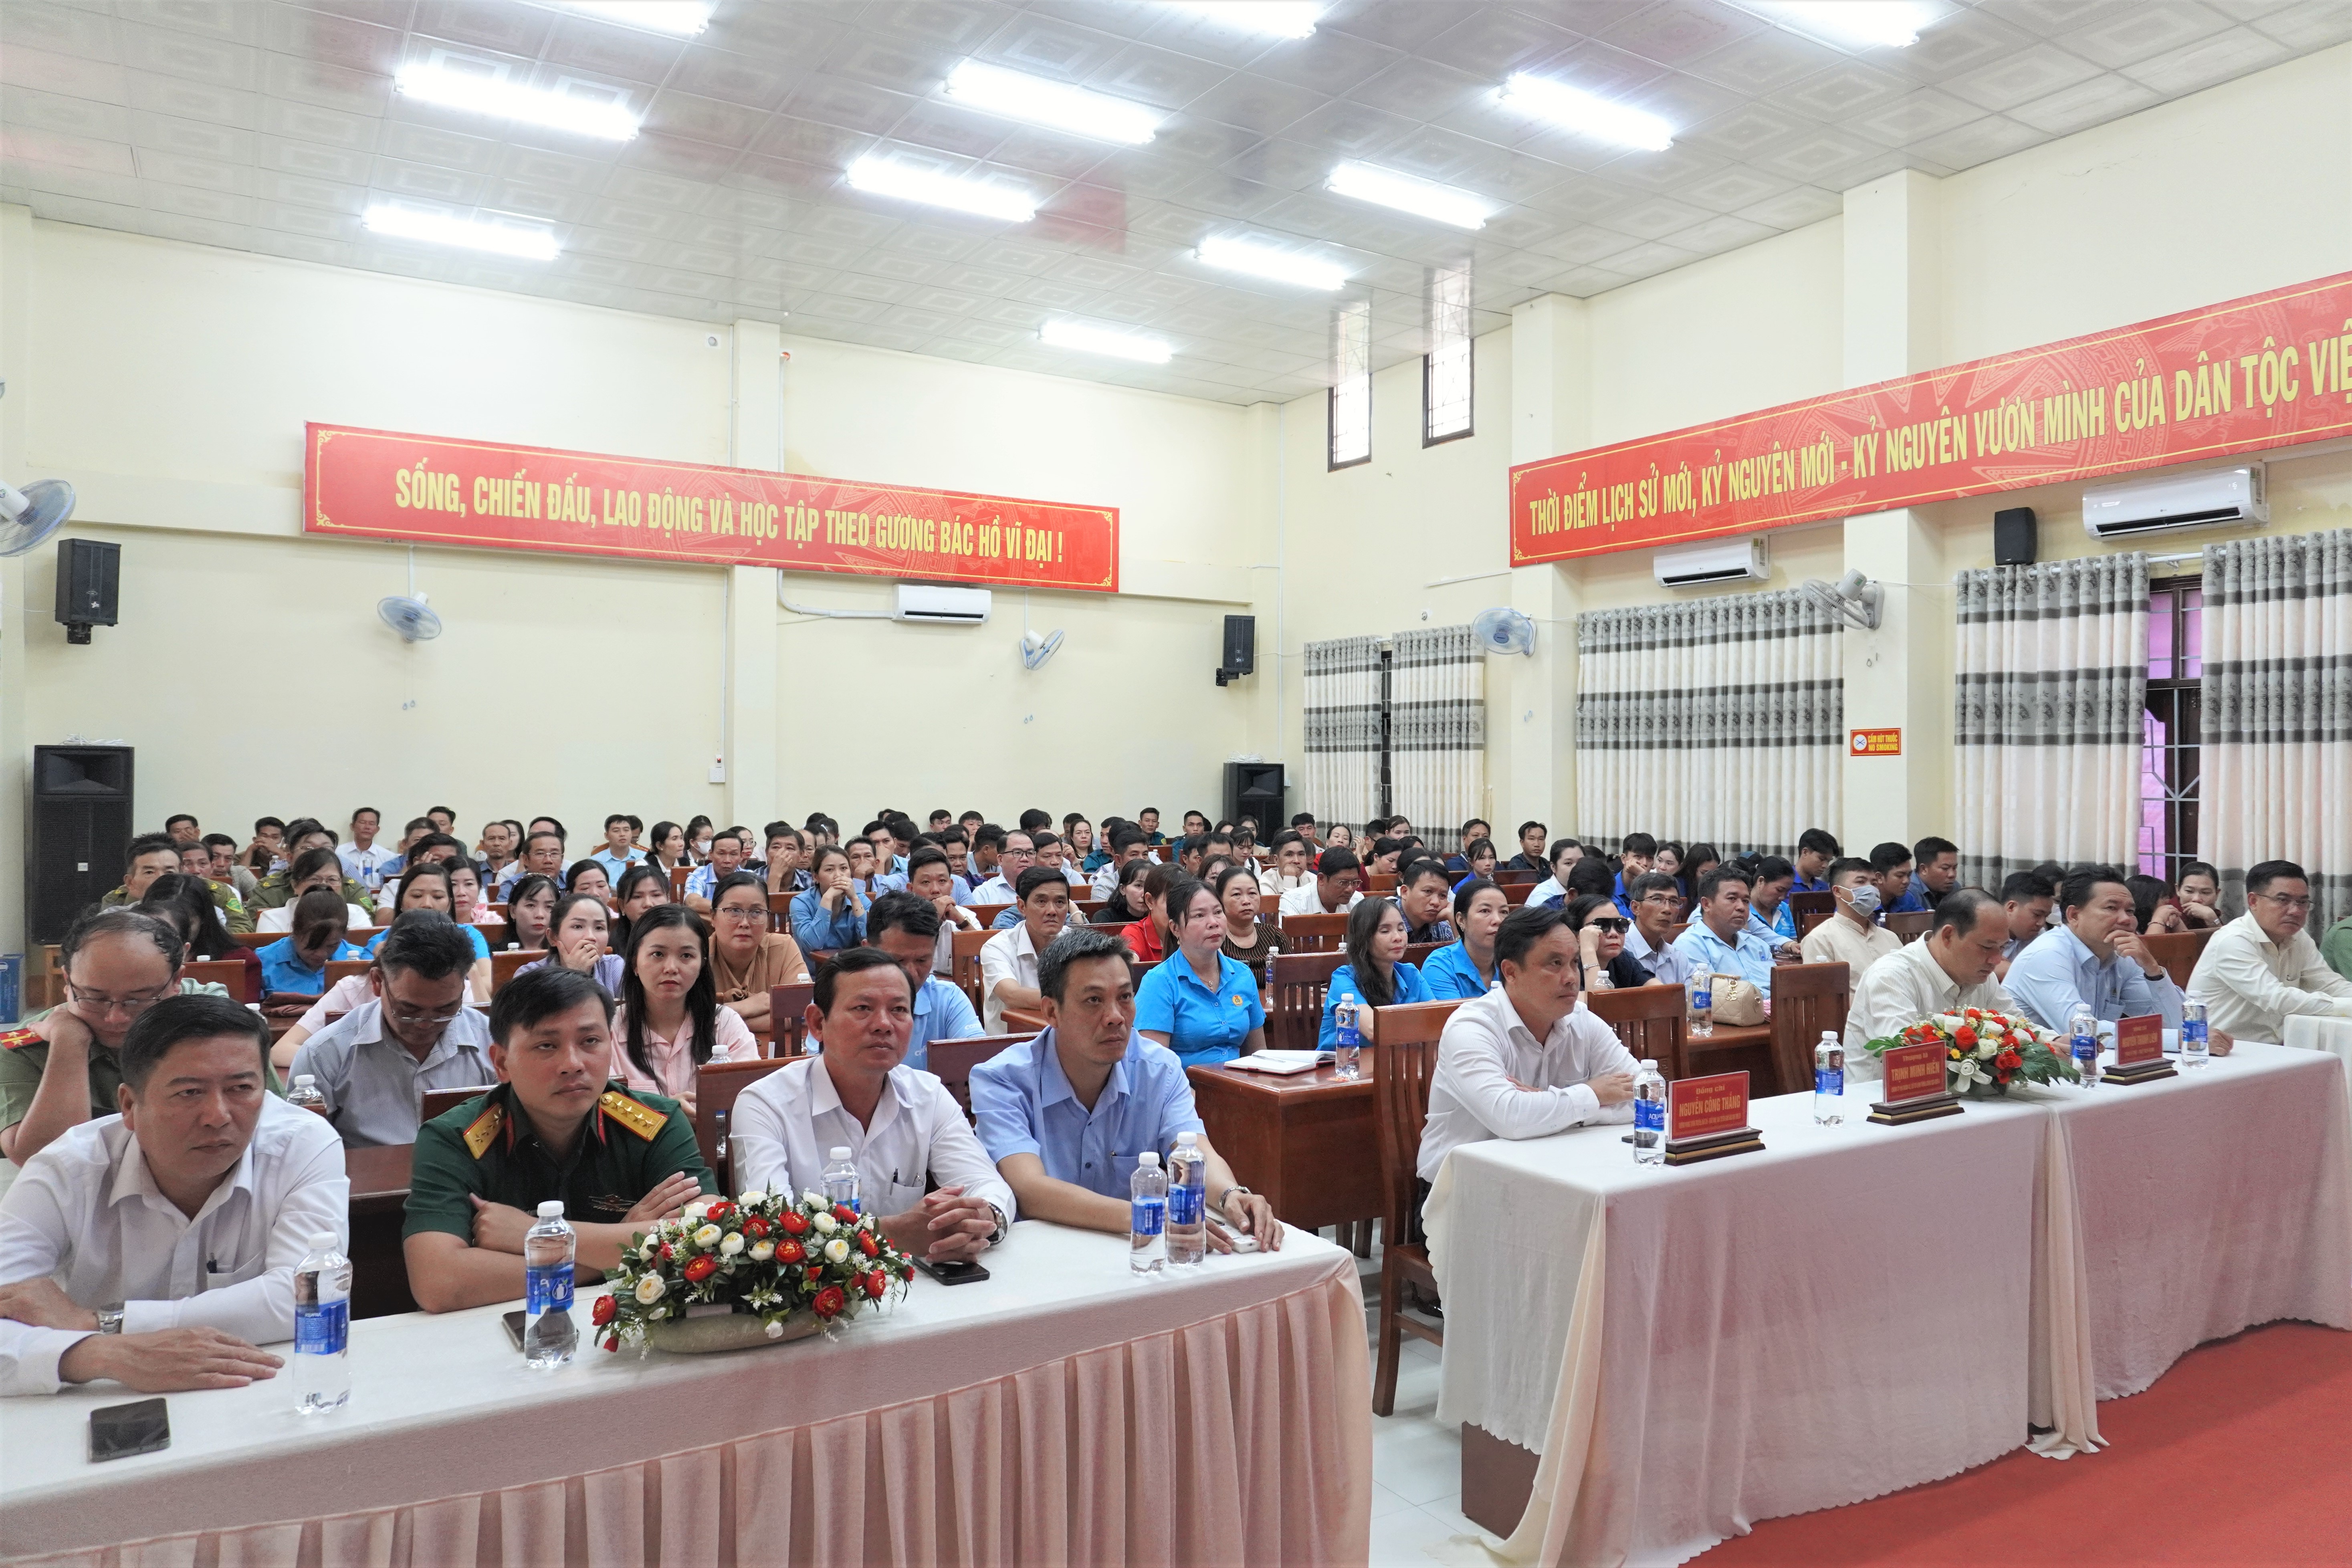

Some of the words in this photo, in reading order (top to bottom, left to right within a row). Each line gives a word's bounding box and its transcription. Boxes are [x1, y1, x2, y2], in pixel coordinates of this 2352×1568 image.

[1529, 488, 1560, 536] THỜI
[1563, 471, 1598, 531] ĐIỂM
[1602, 482, 1634, 532] LỊCH
[1638, 462, 1660, 519] SỬ
[1663, 460, 1697, 517] MỚI,
[1702, 448, 1723, 507] KỶ
[1728, 440, 1795, 502] NGUYÊN
[1800, 430, 1835, 488] MỚI
[1853, 415, 1880, 479] KỶ
[1886, 405, 1968, 474] NGUYÊN
[1974, 396, 2035, 457] VƯƠN
[2043, 380, 2106, 445] MÌNH
[2114, 357, 2166, 433] CỦA
[2175, 350, 2231, 422] DÂN
[2240, 336, 2300, 418] TỘC
[395, 457, 466, 517] SỐNG,
[473, 468, 541, 519] CHIẾN
[546, 472, 596, 528] ĐẤU,
[603, 488, 641, 528] LAO
[647, 487, 703, 538] ĐỘNG
[709, 492, 734, 535] VÀ
[739, 502, 778, 546] HỌC
[783, 499, 820, 549] TẬP
[824, 509, 870, 547] THEO
[875, 513, 935, 553] GƯƠNG
[939, 514, 974, 556] BÁC
[978, 514, 1001, 558] HỒ
[1005, 521, 1022, 560] VĨ
[1025, 528, 1053, 569] ĐẠI
[1868, 733, 1876, 743] CẤM
[1885, 732, 1898, 743] THUỐC
[1704, 1096, 1720, 1113] CÔNG
